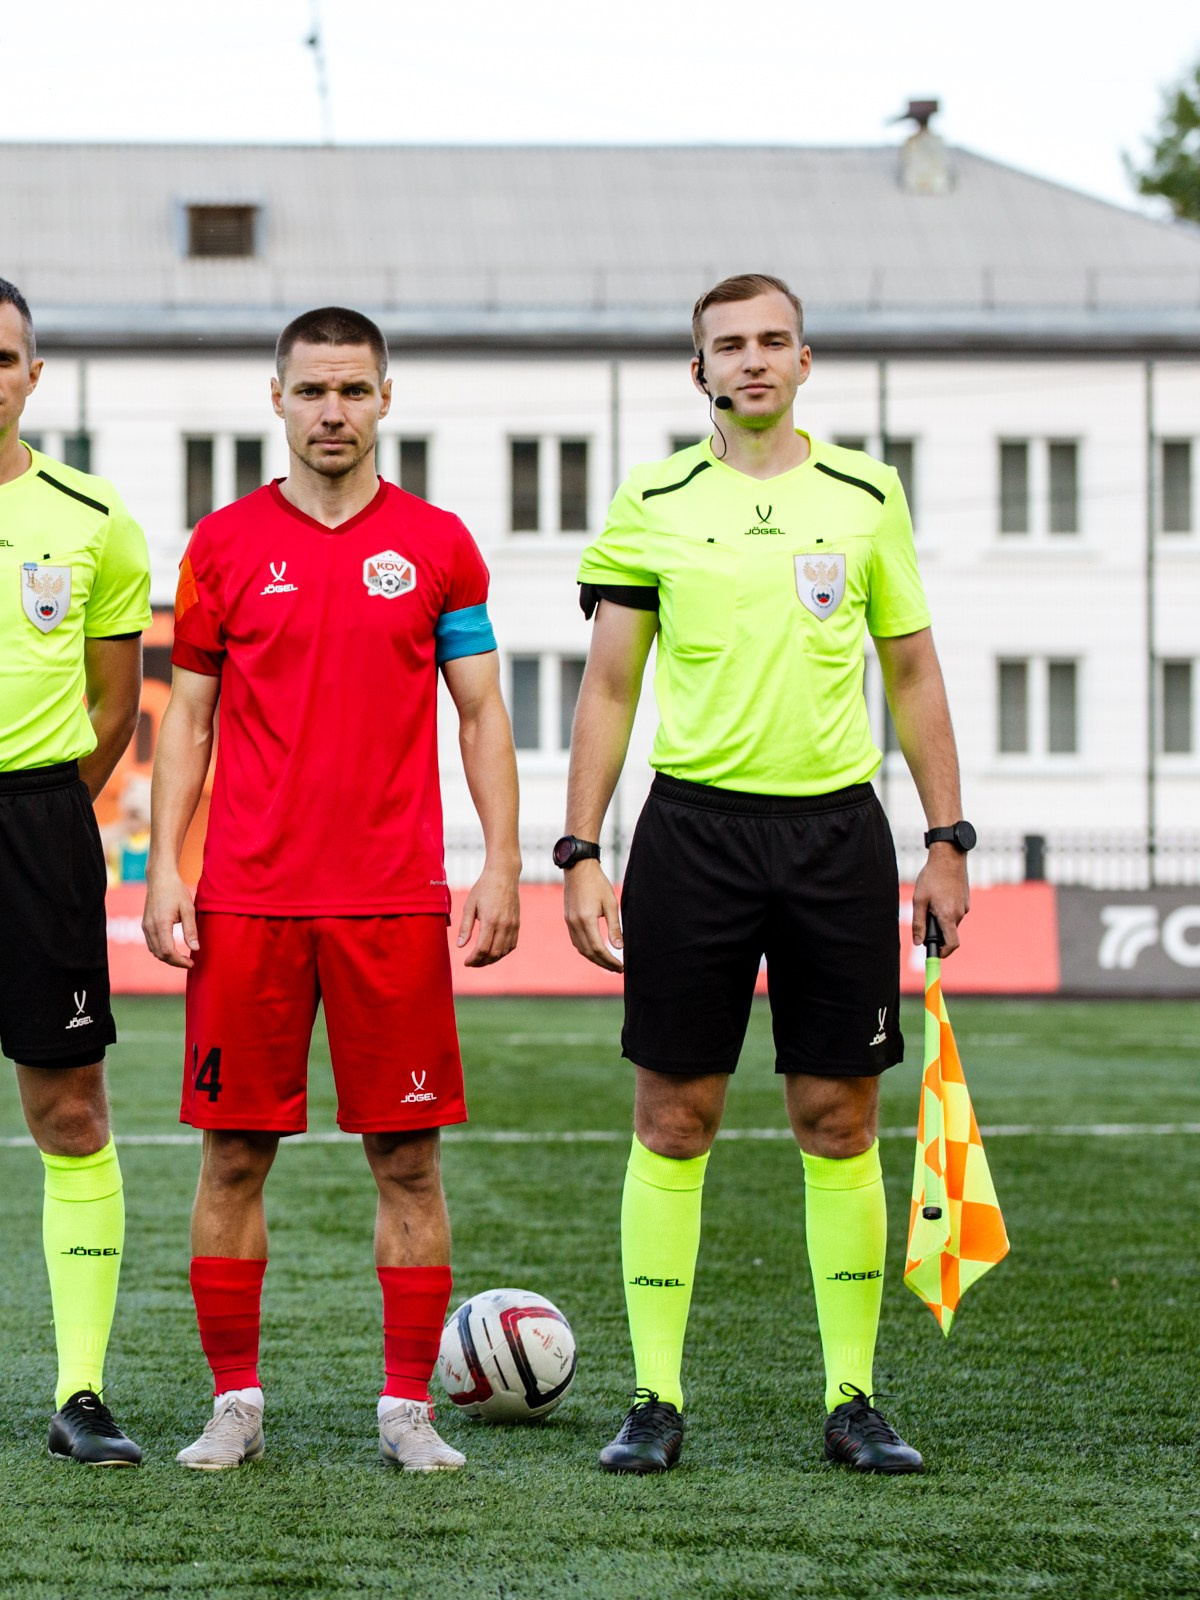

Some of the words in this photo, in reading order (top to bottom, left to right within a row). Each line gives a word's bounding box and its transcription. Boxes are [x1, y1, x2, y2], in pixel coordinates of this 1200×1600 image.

[744, 526, 786, 535] JÖGEL
[377, 562, 404, 571] KDV
[260, 584, 298, 595] JÖGEL
[65, 1016, 94, 1030] JÖGEL
[400, 1092, 437, 1103] JÖGEL
[60, 1246, 120, 1256] JÖGEL
[826, 1270, 882, 1281] JÖGEL
[629, 1276, 685, 1287] JÖGEL
